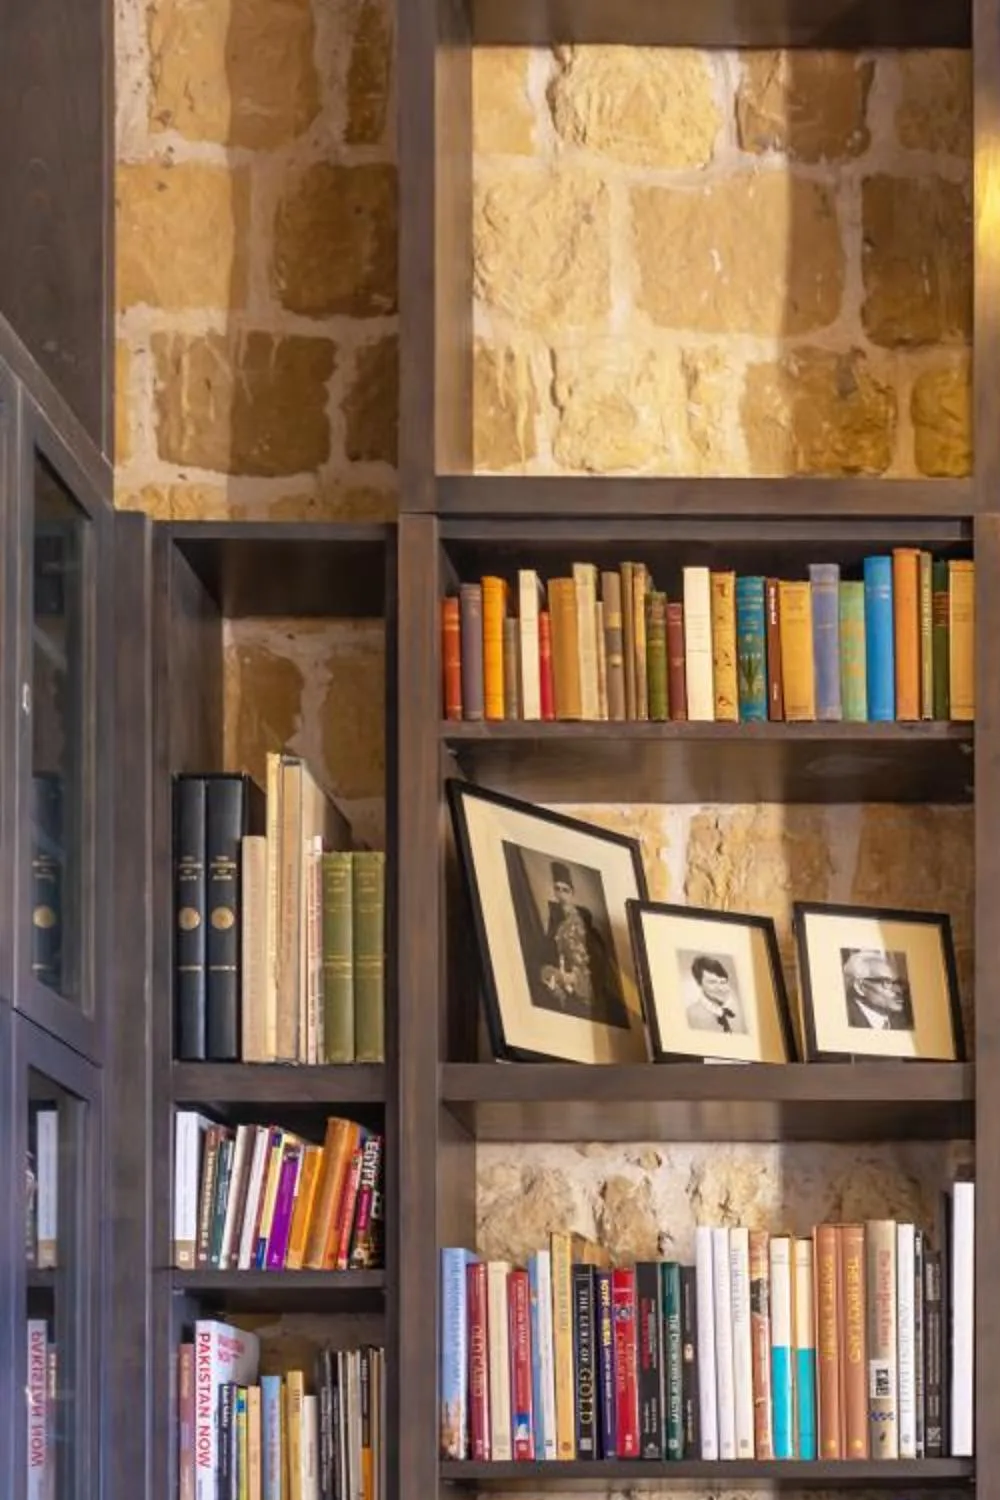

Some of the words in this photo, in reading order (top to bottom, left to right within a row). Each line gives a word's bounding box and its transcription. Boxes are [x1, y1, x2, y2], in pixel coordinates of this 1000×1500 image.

[361, 1141, 380, 1187] EGYPT
[847, 1256, 861, 1283] THE
[579, 1289, 589, 1313] THE
[600, 1279, 611, 1306] EGYPT
[847, 1286, 861, 1322] HOLY
[580, 1349, 590, 1364] OF
[848, 1324, 861, 1363] LAND
[198, 1333, 212, 1419] PAKISTAN
[579, 1367, 593, 1425] GOLD
[199, 1425, 212, 1469] NOW
